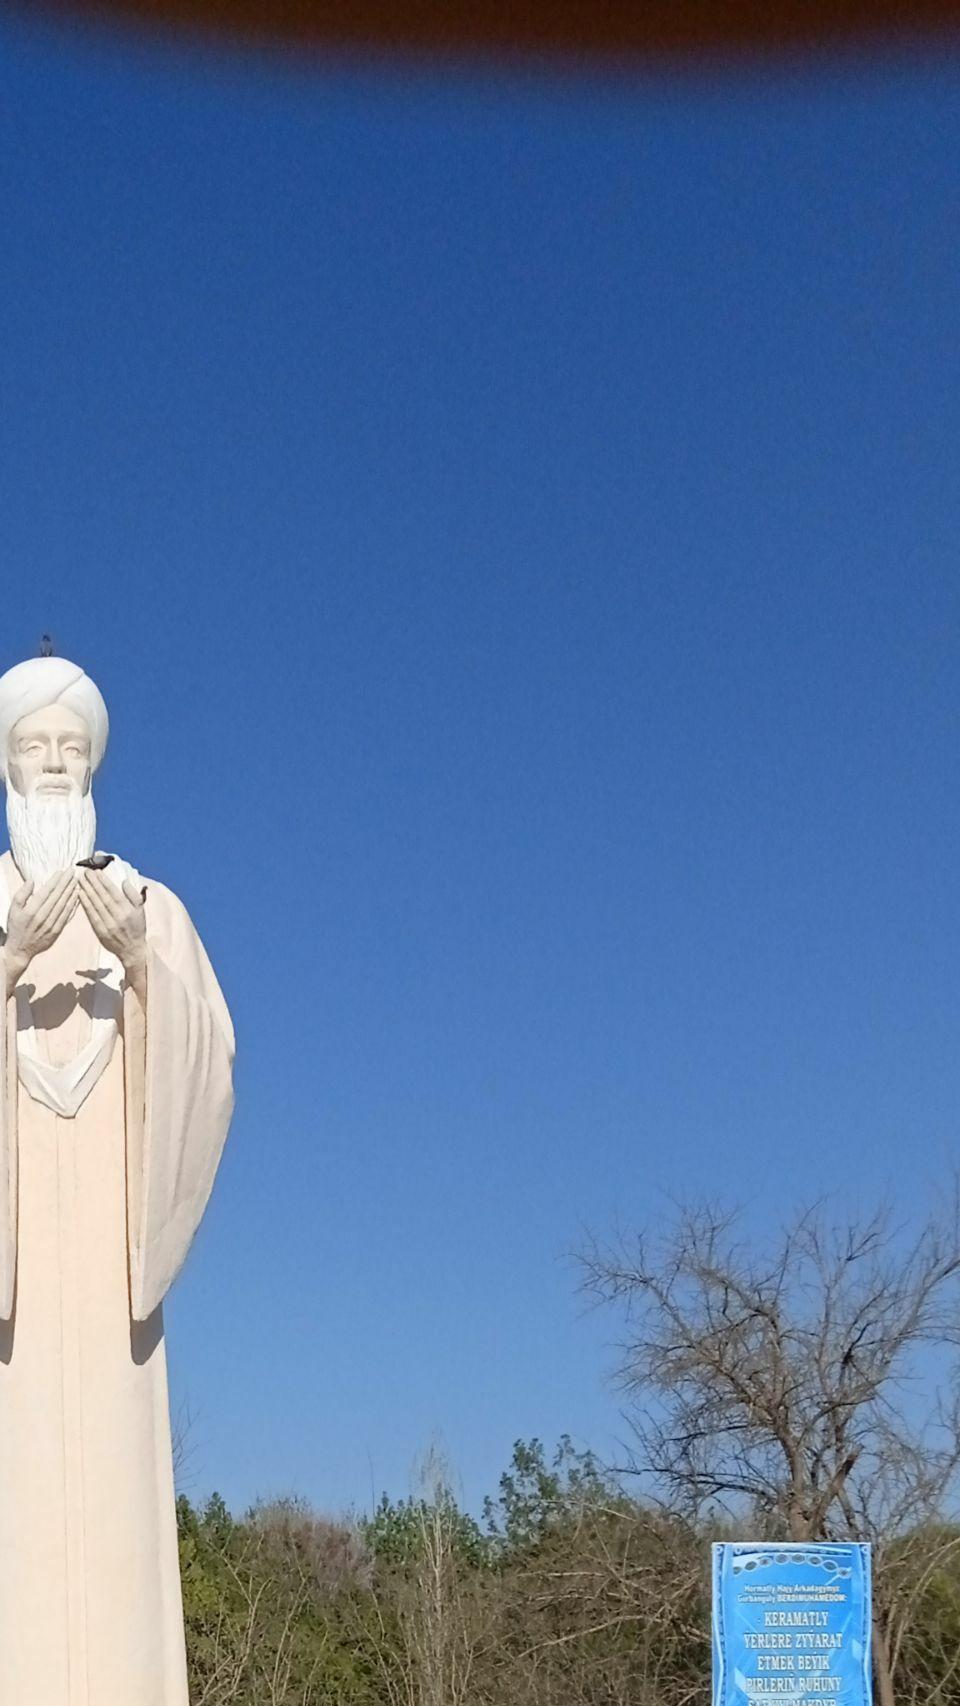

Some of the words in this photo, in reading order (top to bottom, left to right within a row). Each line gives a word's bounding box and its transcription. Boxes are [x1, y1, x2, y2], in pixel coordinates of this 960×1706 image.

[764, 1611, 828, 1626] KERAMATLY
[757, 1655, 795, 1670] ETMEK
[799, 1677, 842, 1692] RUHUNY
